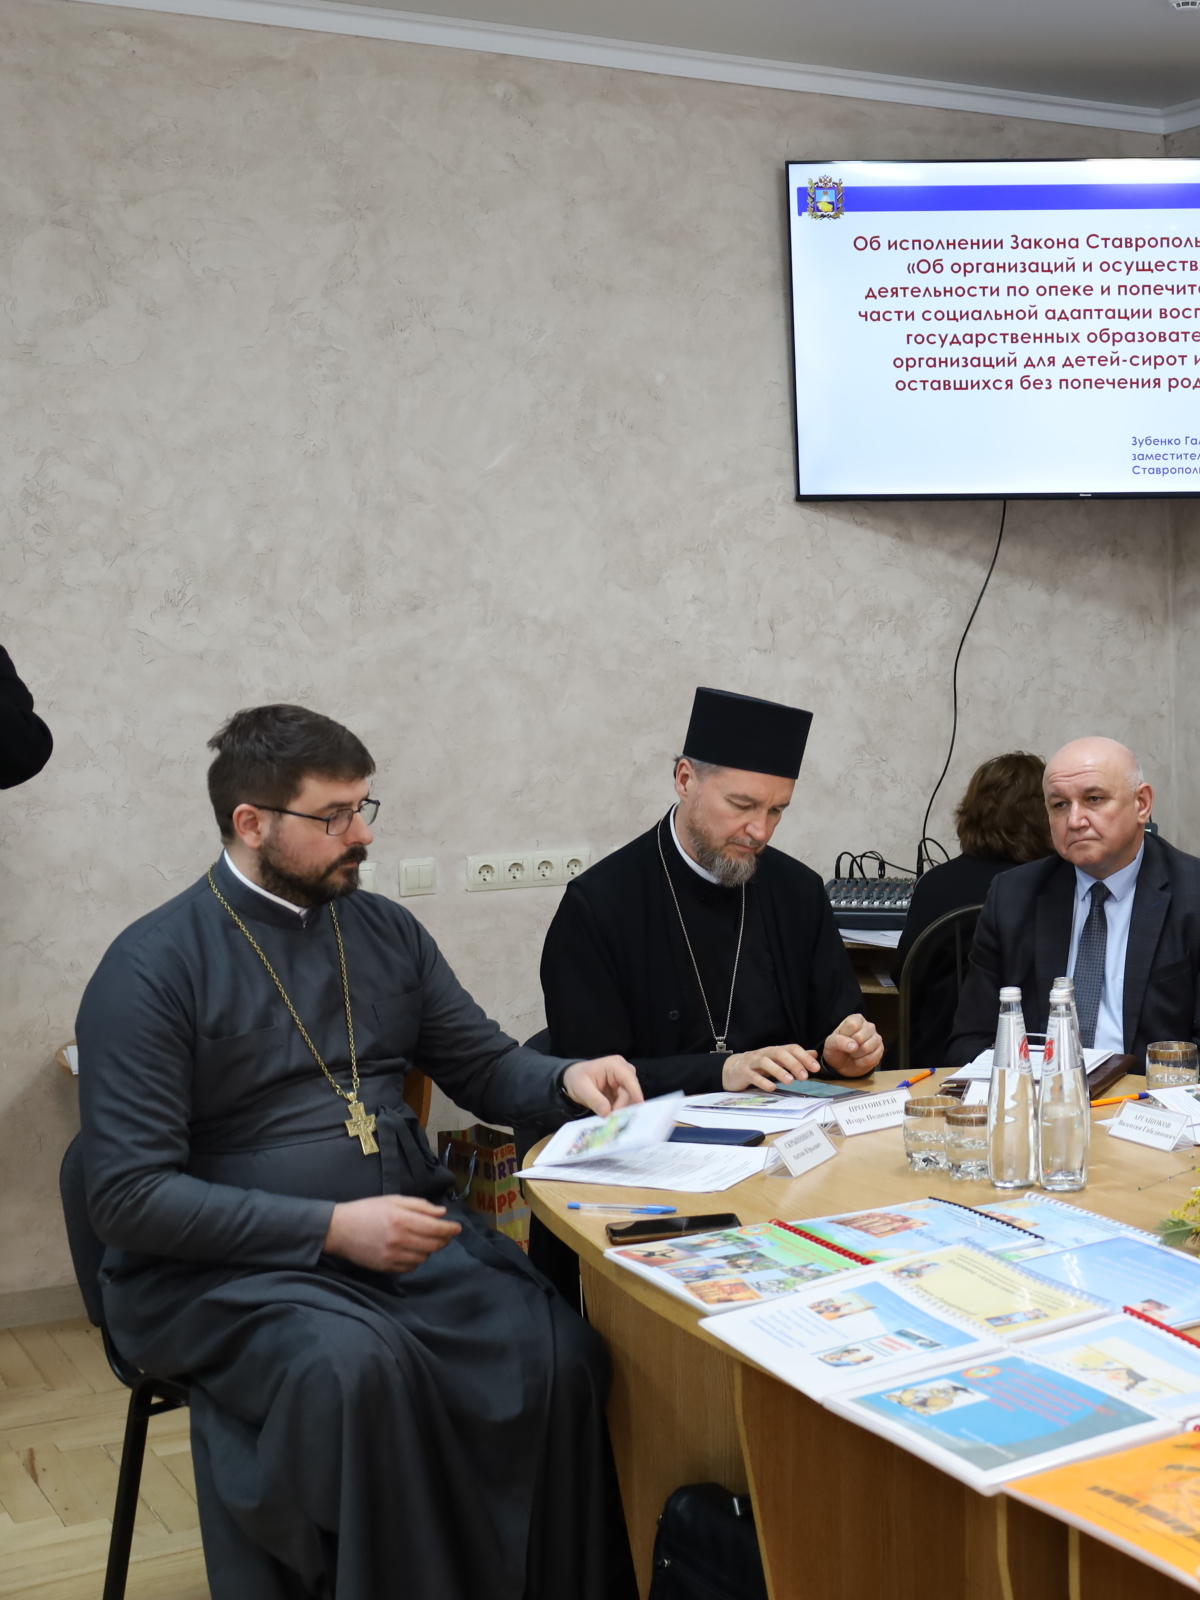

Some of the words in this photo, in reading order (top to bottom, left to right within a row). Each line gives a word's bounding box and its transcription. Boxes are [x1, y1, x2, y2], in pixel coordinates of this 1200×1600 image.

[853, 235, 881, 251] Об
[888, 238, 1003, 251] исполнении
[1010, 234, 1079, 250] Закона
[907, 258, 944, 274] «Об
[950, 257, 1075, 277] организаций
[1083, 261, 1092, 272] и
[865, 286, 1000, 300] деятельности
[1007, 285, 1029, 297] по
[1036, 285, 1094, 297] опеке
[1101, 285, 1110, 296] и
[858, 310, 915, 322] части
[922, 305, 1038, 323] социальной
[1045, 308, 1152, 322] адаптации
[906, 332, 1081, 348] государственных
[893, 352, 1017, 372] организаций
[1023, 356, 1055, 369] для
[1062, 351, 1188, 370] детей-сирот
[895, 379, 1013, 391] оставшихся
[1020, 375, 1052, 390] без
[1059, 378, 1161, 389] попечения
[1132, 436, 1181, 448] Зубенко
[848, 1097, 897, 1113] ПРОТОИЕРЕЙ
[867, 1109, 904, 1121] Подоситник
[1134, 1114, 1172, 1129] АРГАШОКОВ
